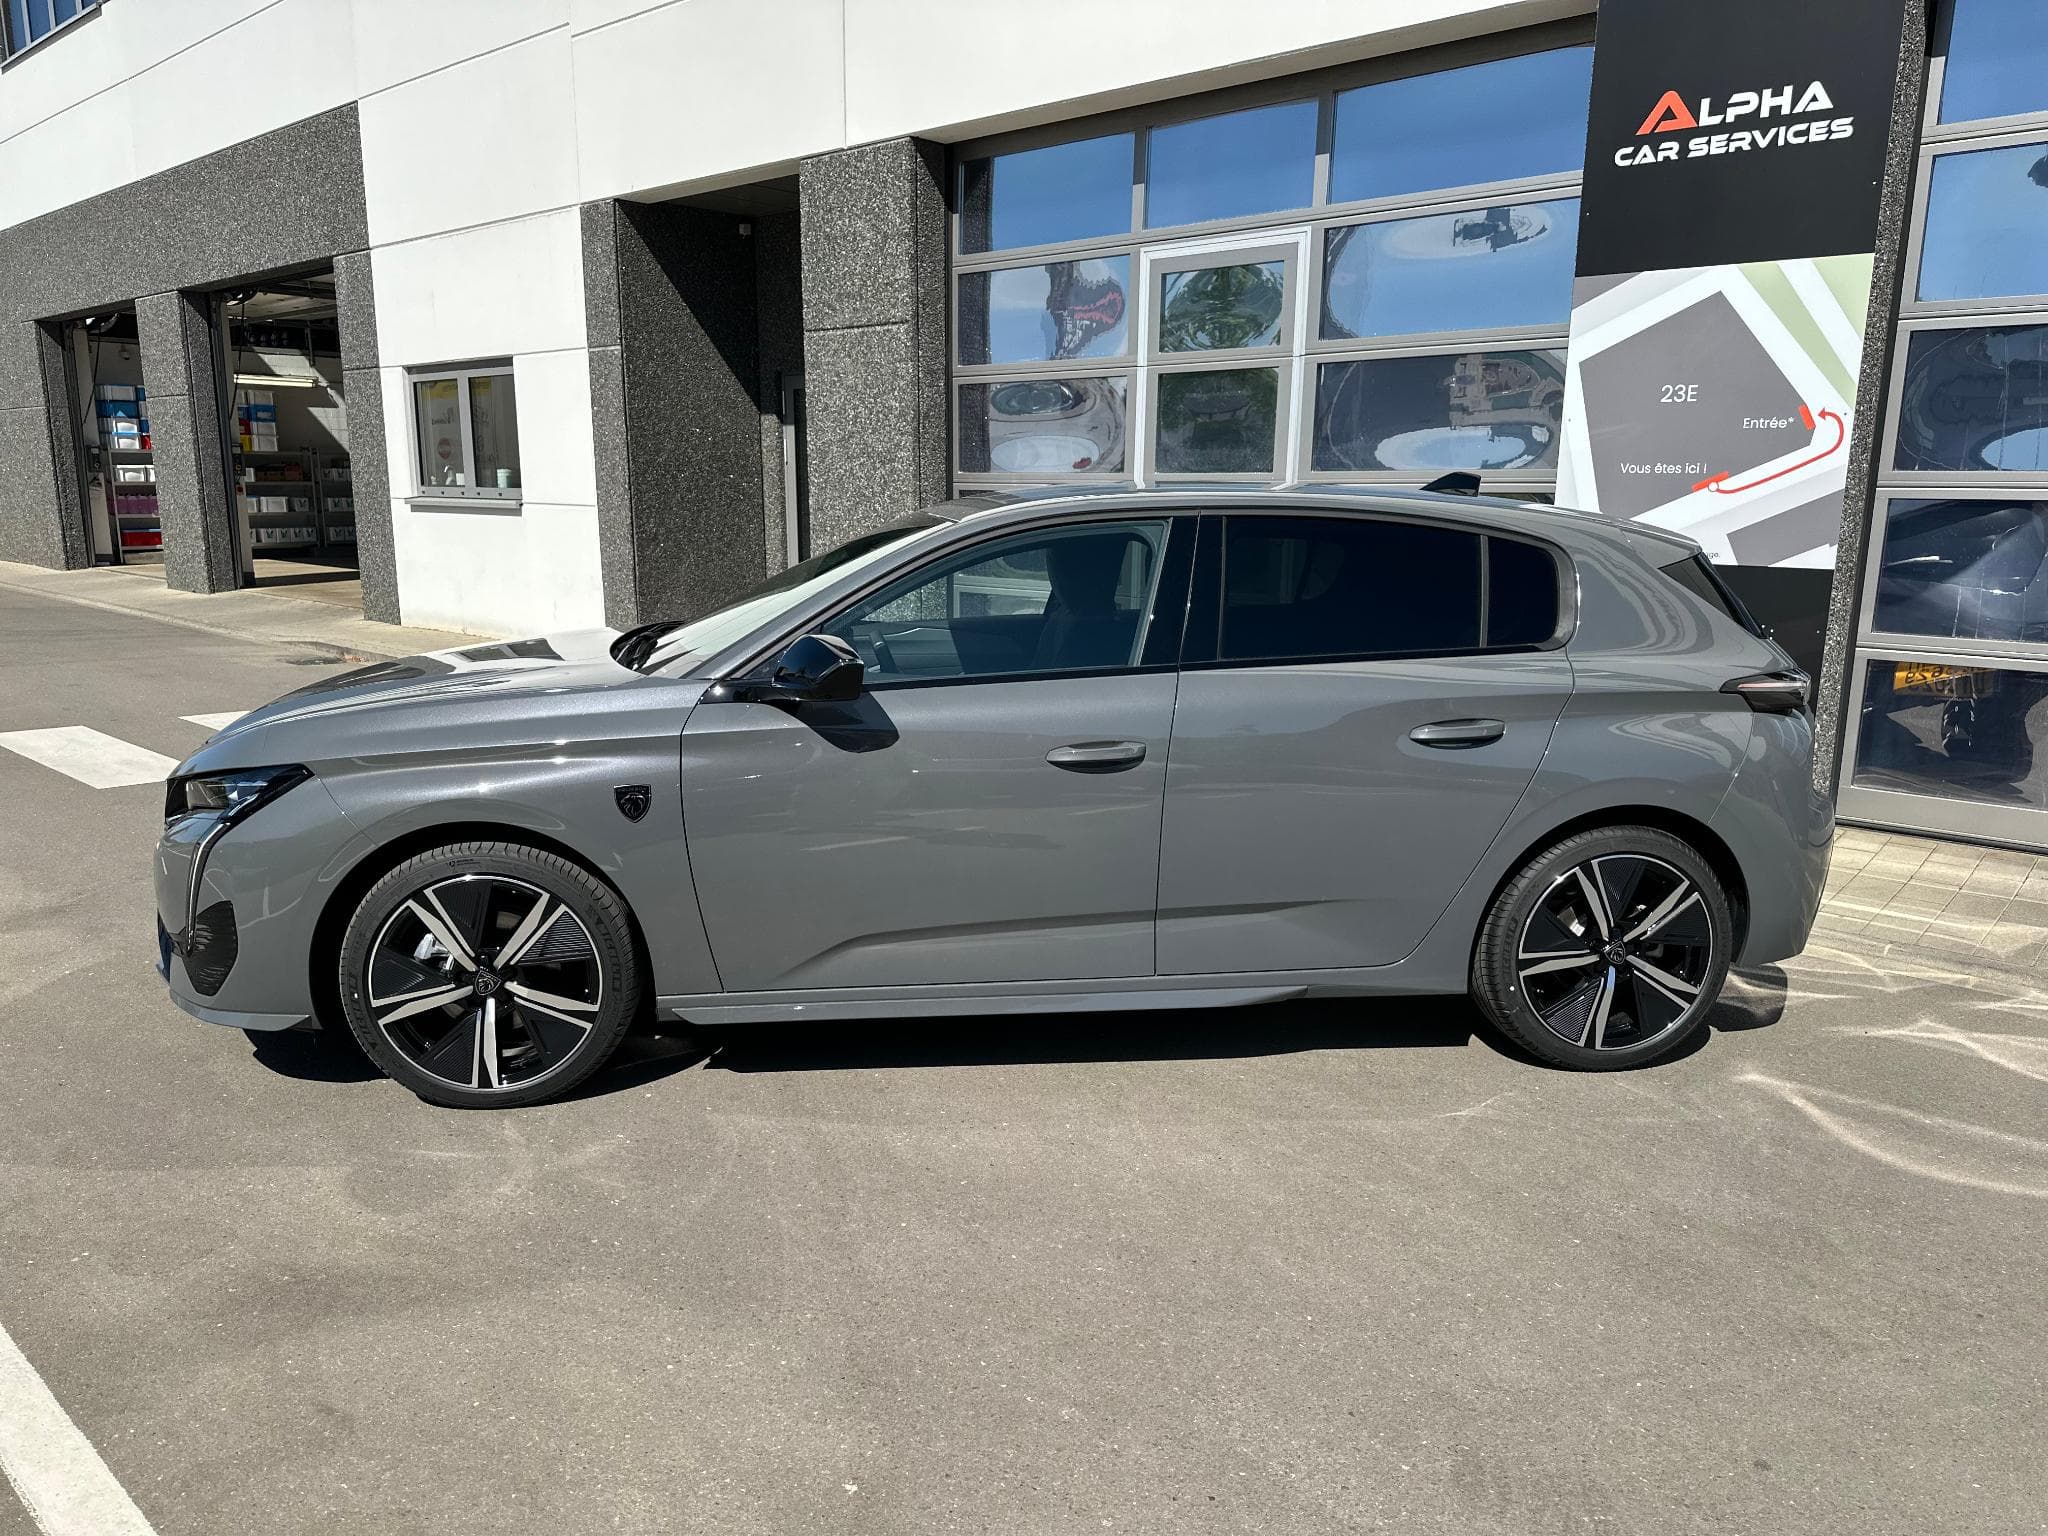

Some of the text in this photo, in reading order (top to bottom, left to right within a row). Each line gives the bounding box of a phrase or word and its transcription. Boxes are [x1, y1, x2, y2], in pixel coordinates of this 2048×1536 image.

[1635, 80, 1834, 136] ALPHA
[1614, 116, 1854, 167] CAR SERVICES
[1660, 384, 1699, 403] 23E
[1620, 462, 1651, 474] Vous
[1654, 462, 1682, 474] êtes
[1684, 462, 1701, 474] ici
